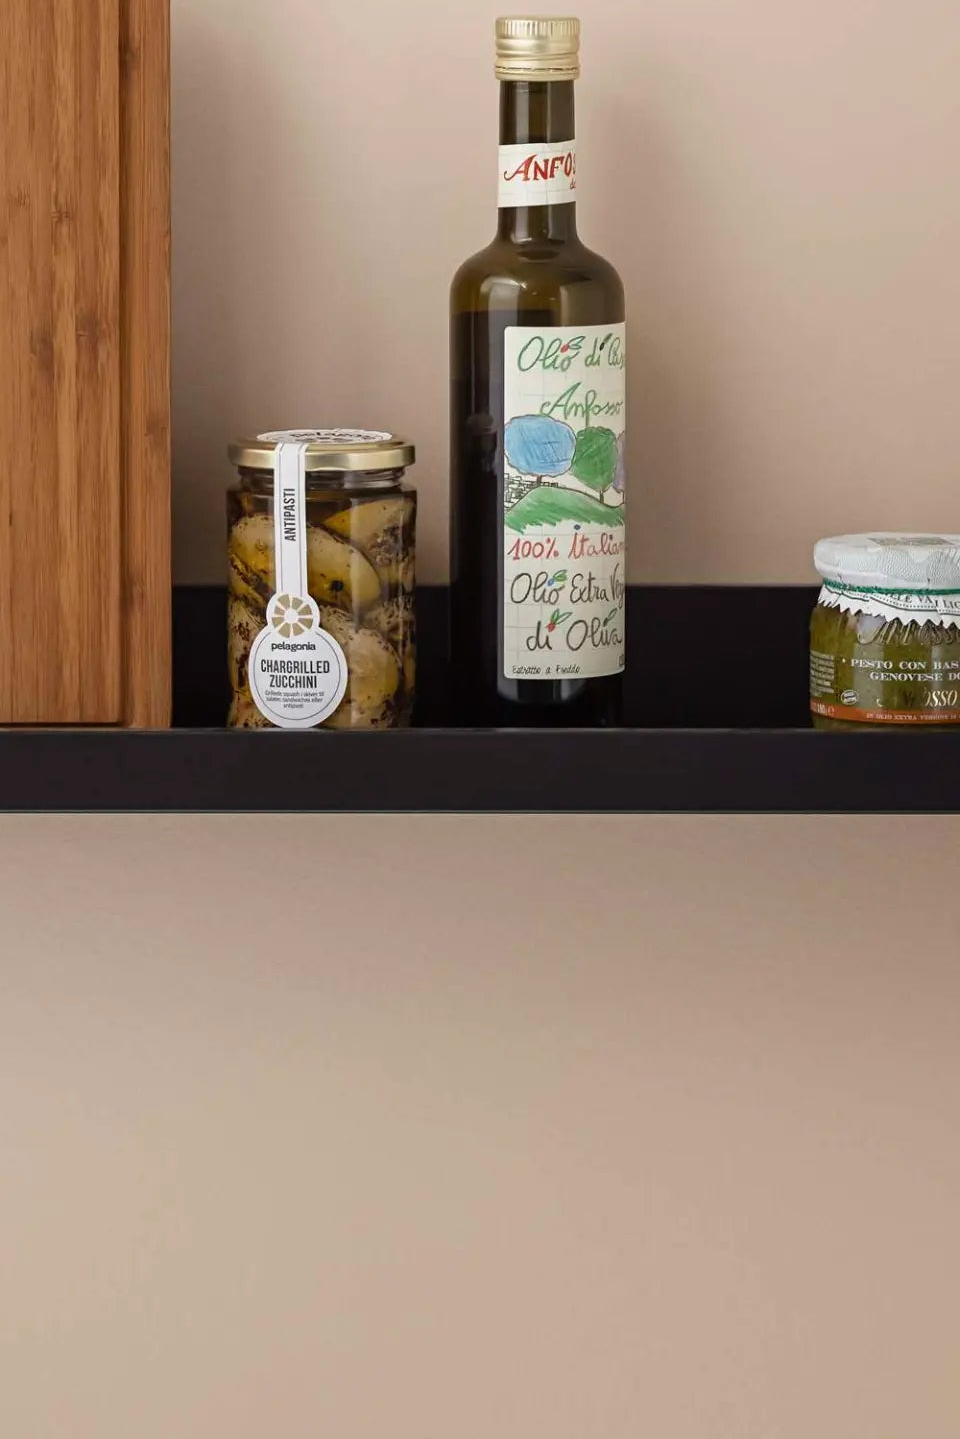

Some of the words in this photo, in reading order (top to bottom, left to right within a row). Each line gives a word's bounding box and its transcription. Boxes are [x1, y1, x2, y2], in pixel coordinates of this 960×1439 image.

[518, 336, 580, 372] Olio
[284, 488, 296, 542] ANTIPASTI
[507, 536, 560, 560] 100%
[510, 571, 566, 605] Olio
[569, 572, 609, 604] Extra
[526, 621, 552, 651] di
[566, 616, 623, 651] Oliva
[271, 642, 316, 652] pelagonia
[260, 659, 330, 674] CHARGRILLED
[850, 658, 893, 670] PESTO
[899, 661, 926, 670] CON
[933, 661, 960, 670] BAS
[269, 674, 317, 689] ZUCCHINI
[870, 671, 943, 681] GENOVESE
